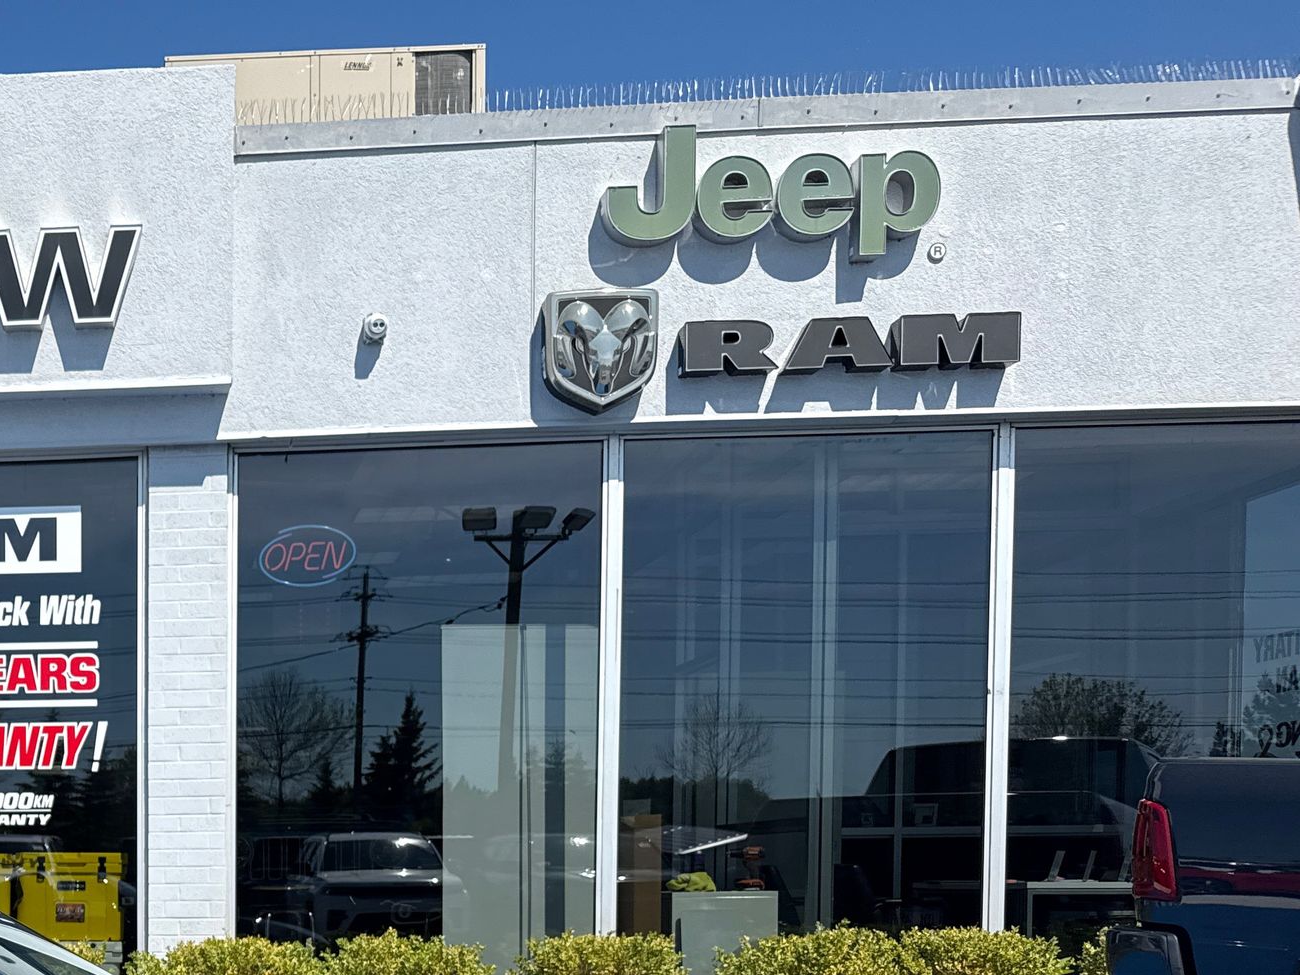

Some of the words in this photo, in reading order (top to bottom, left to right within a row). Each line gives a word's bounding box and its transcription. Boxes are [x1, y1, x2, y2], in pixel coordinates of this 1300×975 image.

[599, 125, 941, 263] Jeep
[678, 312, 1022, 379] RAM
[264, 540, 348, 572] OPEN
[39, 594, 101, 626] With
